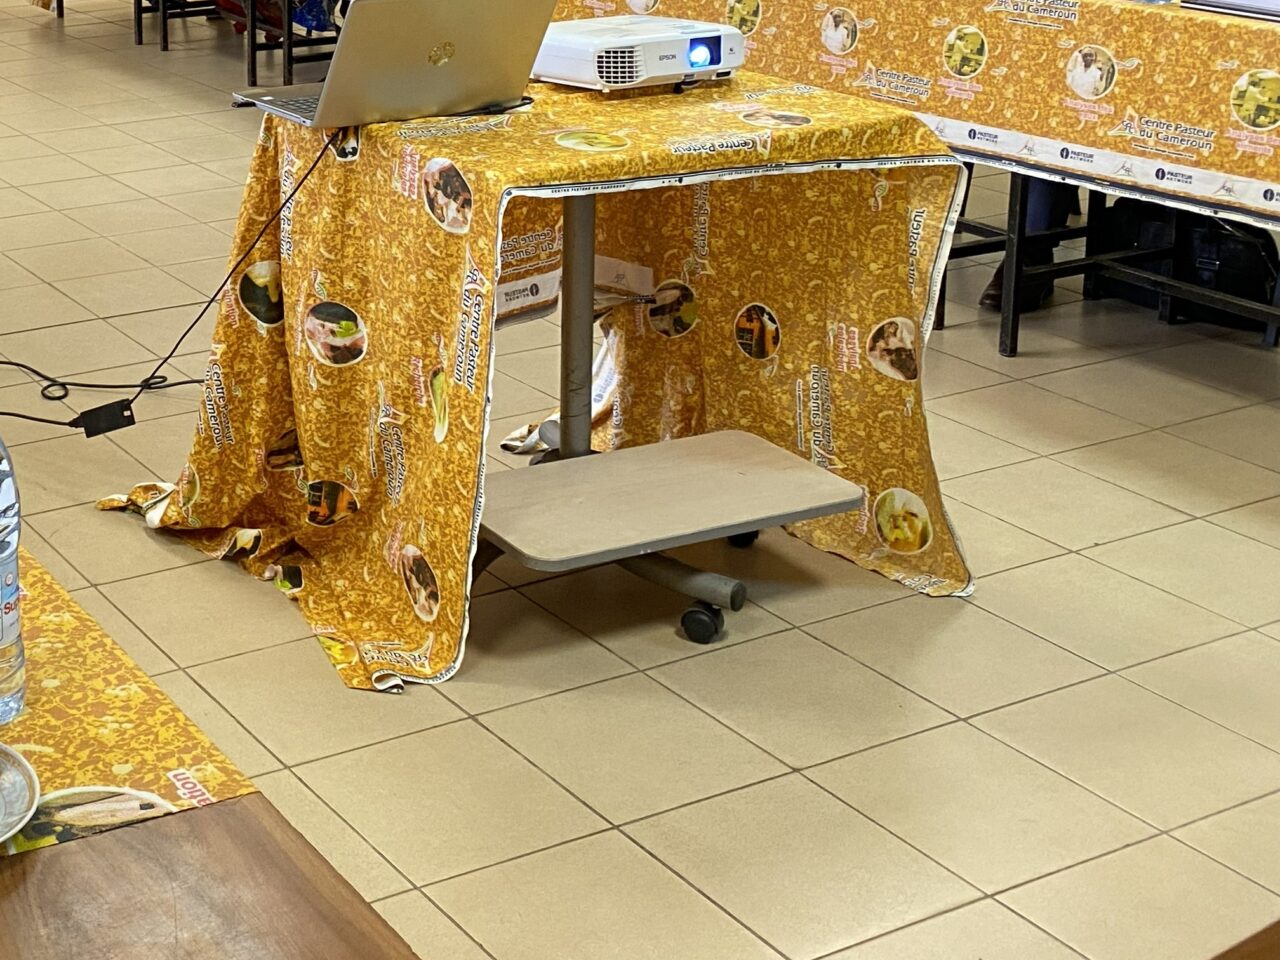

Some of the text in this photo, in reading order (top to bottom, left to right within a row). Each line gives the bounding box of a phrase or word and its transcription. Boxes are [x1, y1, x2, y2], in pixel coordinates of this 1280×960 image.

[1012, 3, 1077, 19] du Cameroun
[875, 68, 931, 86] Centre Pasteur
[876, 80, 929, 96] du Cameroun
[977, 131, 999, 139] PASTEUR
[1140, 116, 1215, 139] Centre Pasteur
[719, 139, 755, 152] Centre
[1140, 128, 1213, 150] du Cameroun
[1070, 150, 1094, 160] PASTEUR
[1166, 171, 1193, 180] PASTEUR
[455, 289, 472, 382] du Cameroun
[465, 293, 484, 393] Centre Pasteur
[211, 362, 226, 404] Centre
[391, 425, 405, 463] Centre
[379, 421, 394, 497] du Cameroun
